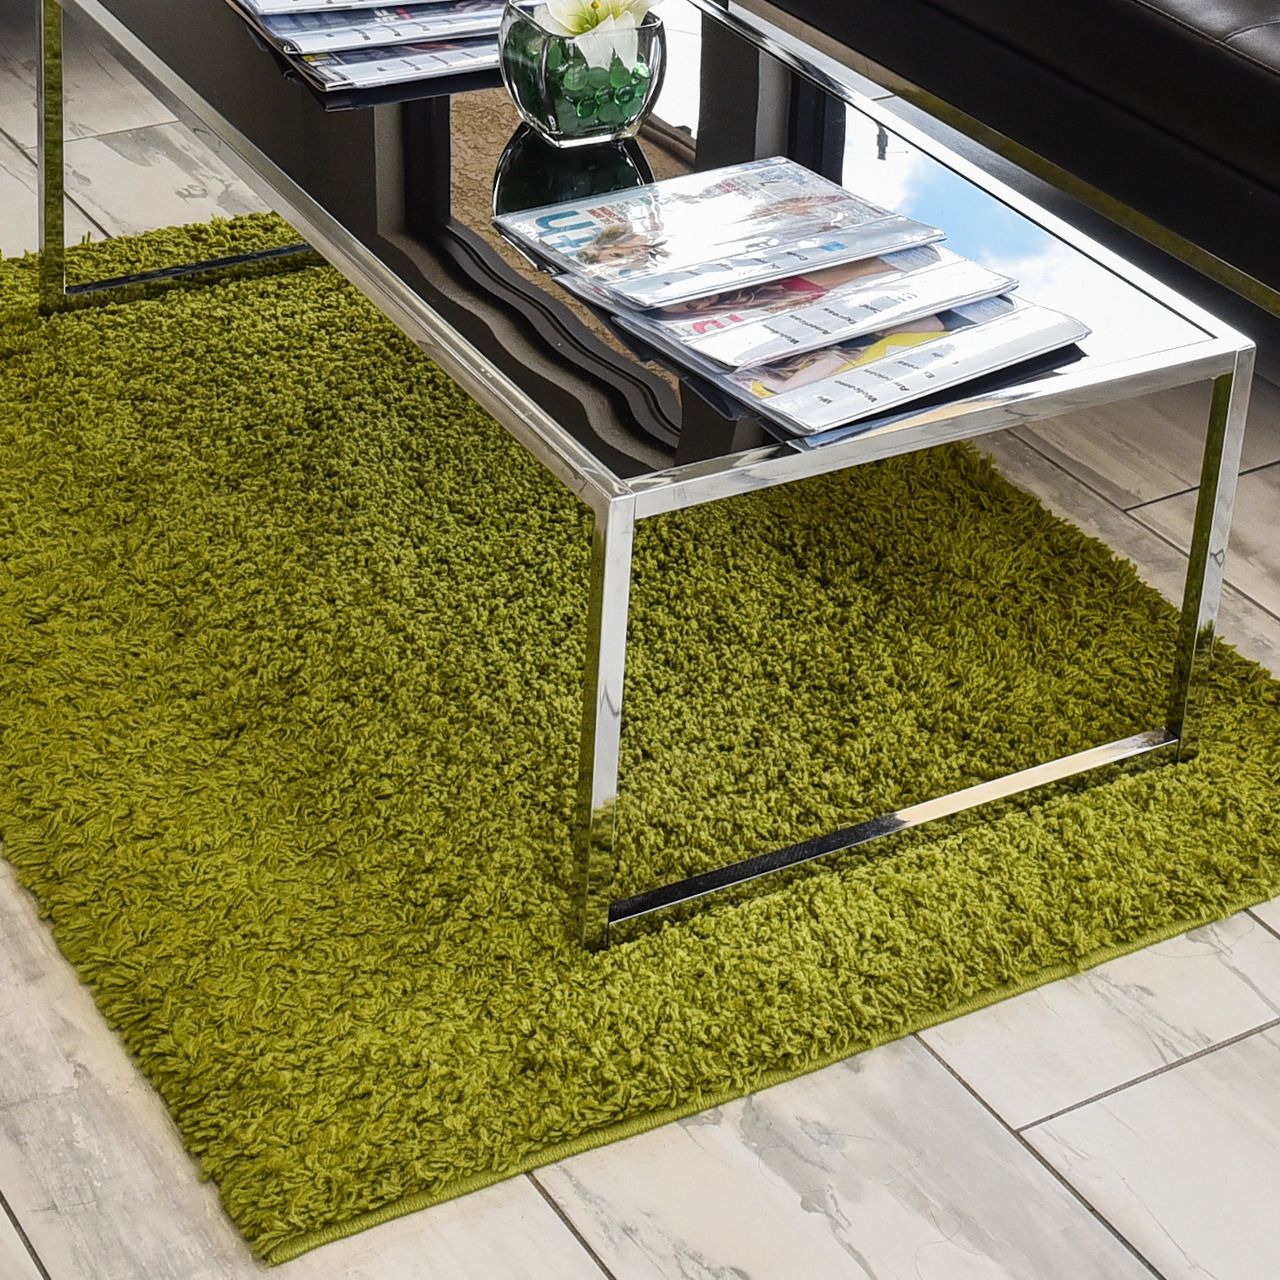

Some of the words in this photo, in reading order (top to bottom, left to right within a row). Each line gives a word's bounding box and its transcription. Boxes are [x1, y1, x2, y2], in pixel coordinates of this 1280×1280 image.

[789, 313, 832, 335] American
[822, 307, 857, 325] Express
[833, 378, 879, 404] Welcome
